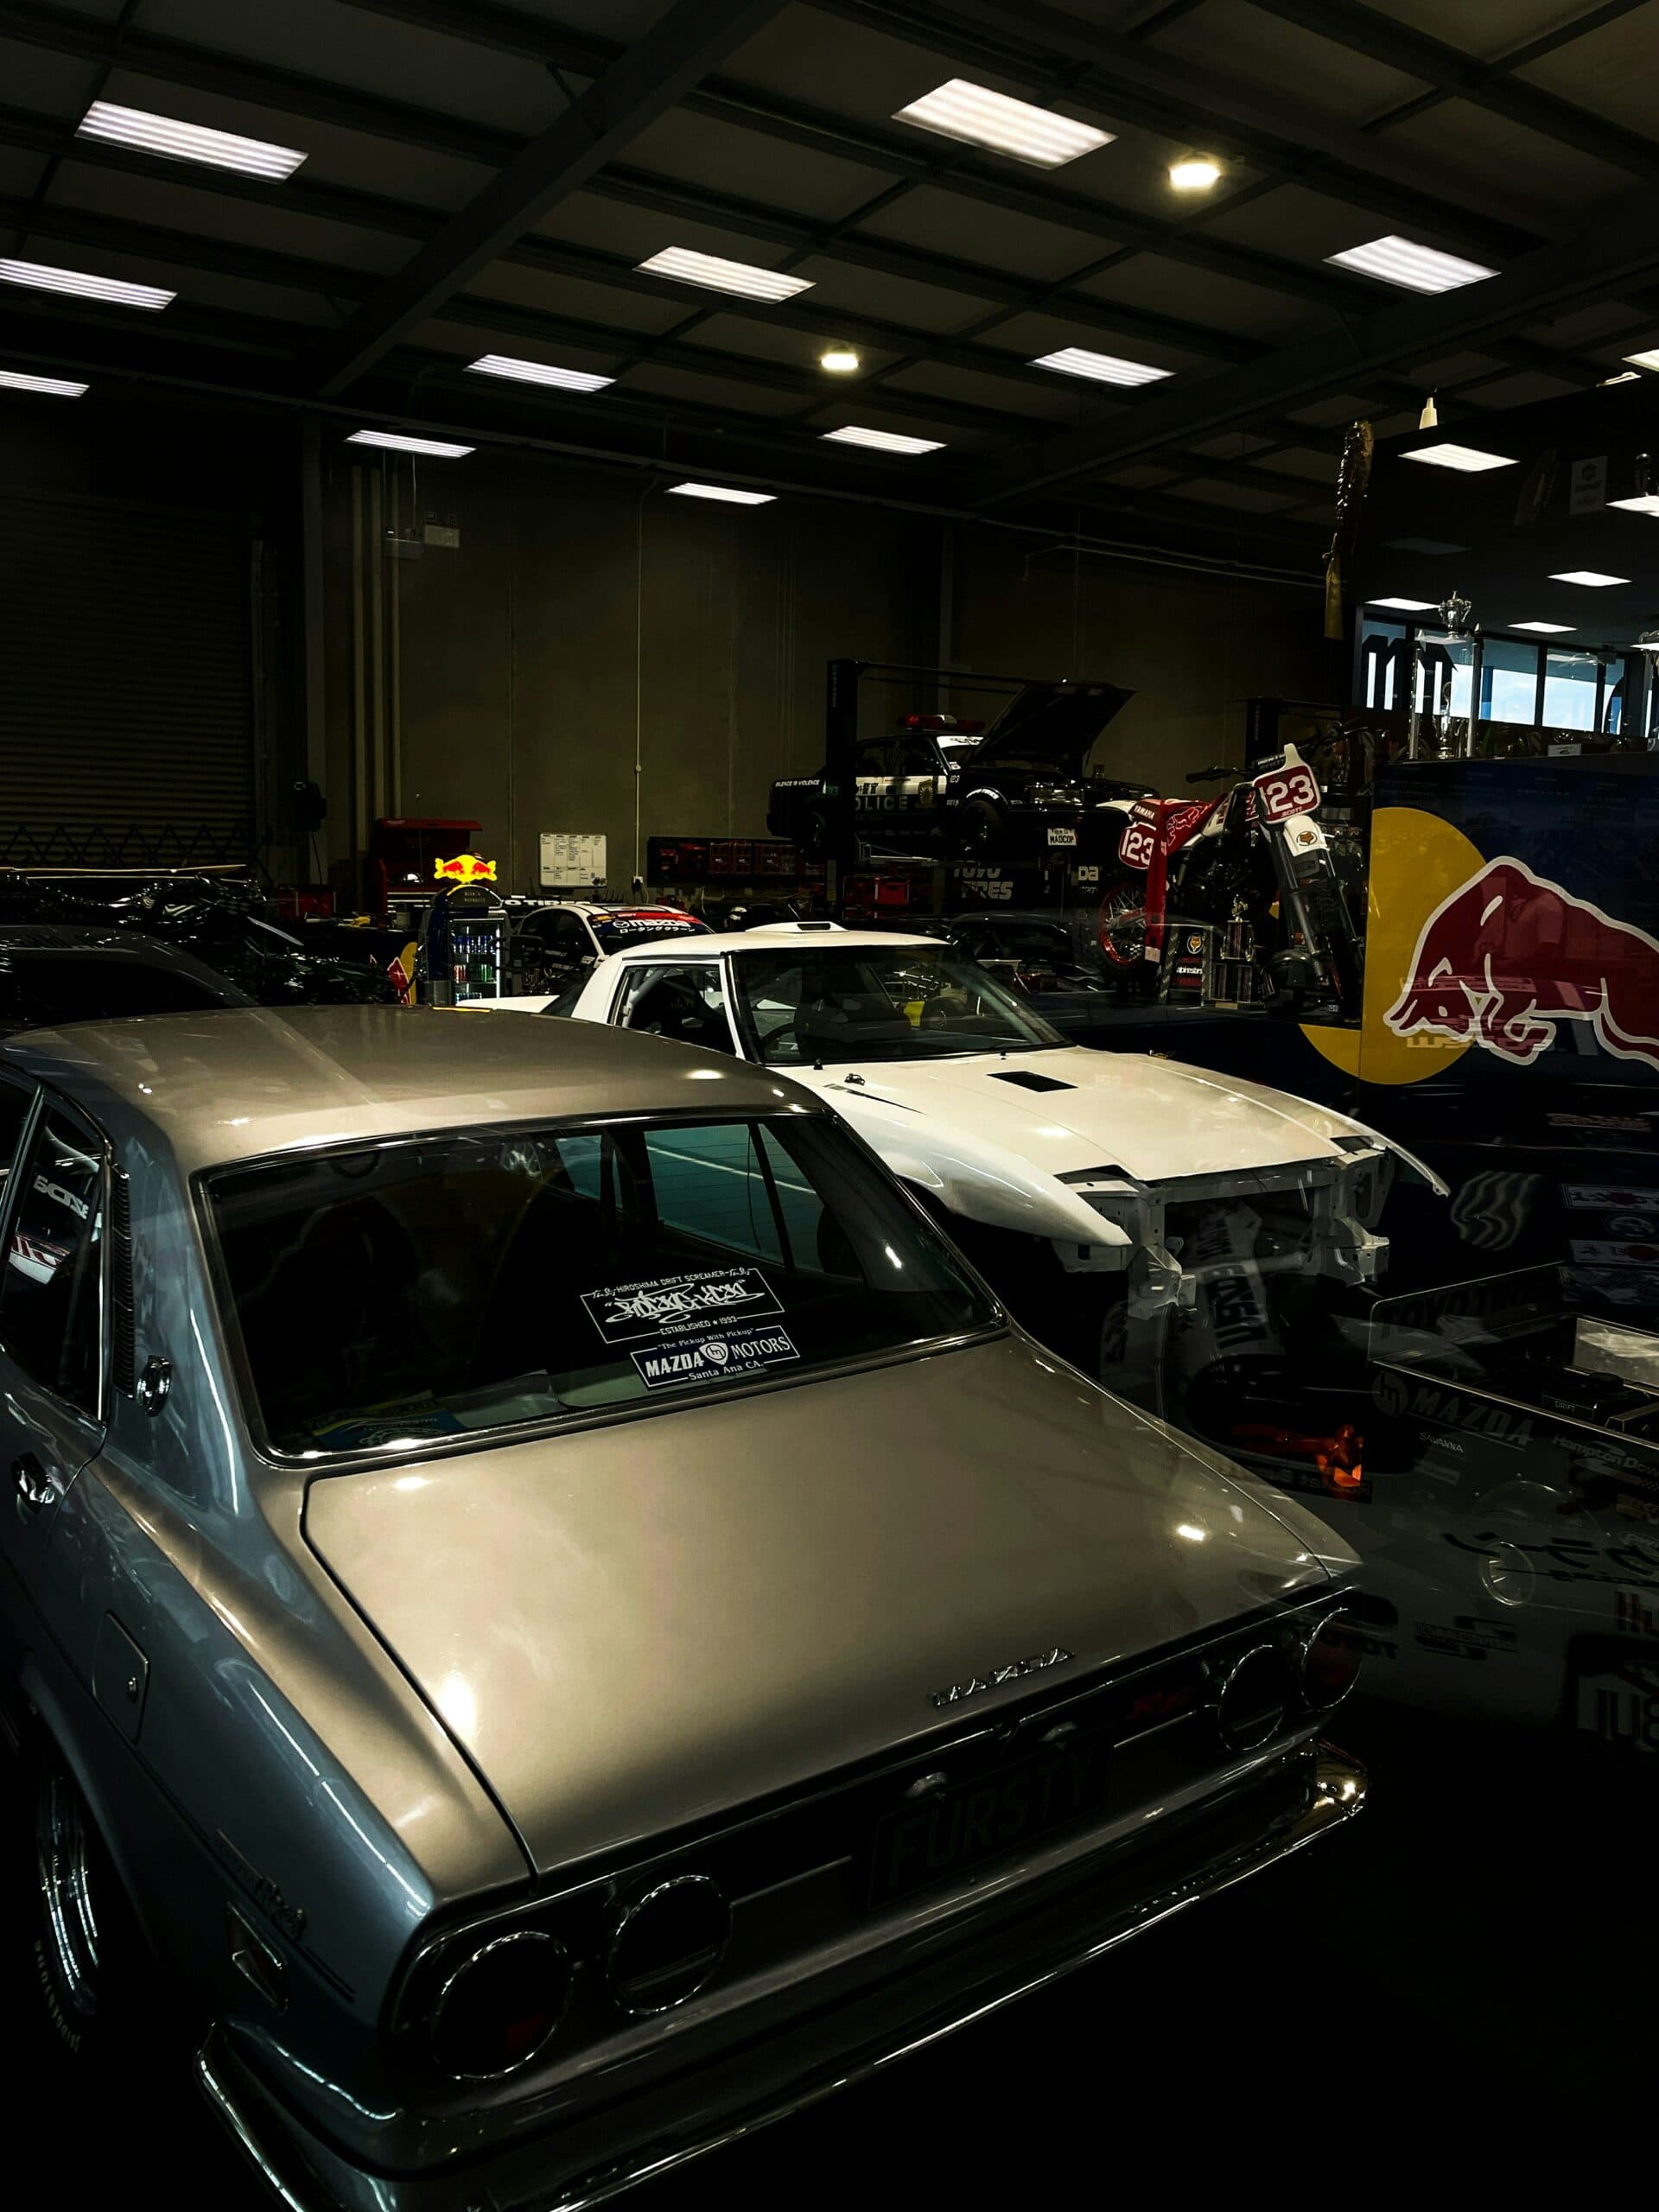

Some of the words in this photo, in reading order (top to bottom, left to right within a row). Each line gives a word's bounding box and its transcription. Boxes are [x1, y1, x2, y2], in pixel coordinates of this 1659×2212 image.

[855, 796, 907, 810] OLICE
[1258, 774, 1315, 816] 123
[1121, 828, 1154, 866] 123
[616, 1281, 659, 1293] HIROSHIMA
[662, 1276, 683, 1286] DRIFT
[686, 1270, 726, 1282] SCREAMER
[659, 1320, 711, 1335] ESTABLISHED
[719, 1316, 737, 1325] 1993
[678, 1336, 705, 1347] Pickup
[645, 1351, 704, 1377] MAZDA
[730, 1336, 791, 1359] MOTORS
[688, 1367, 719, 1381] Santa
[723, 1364, 743, 1374] Ana
[1409, 1387, 1535, 1446] MAZDA
